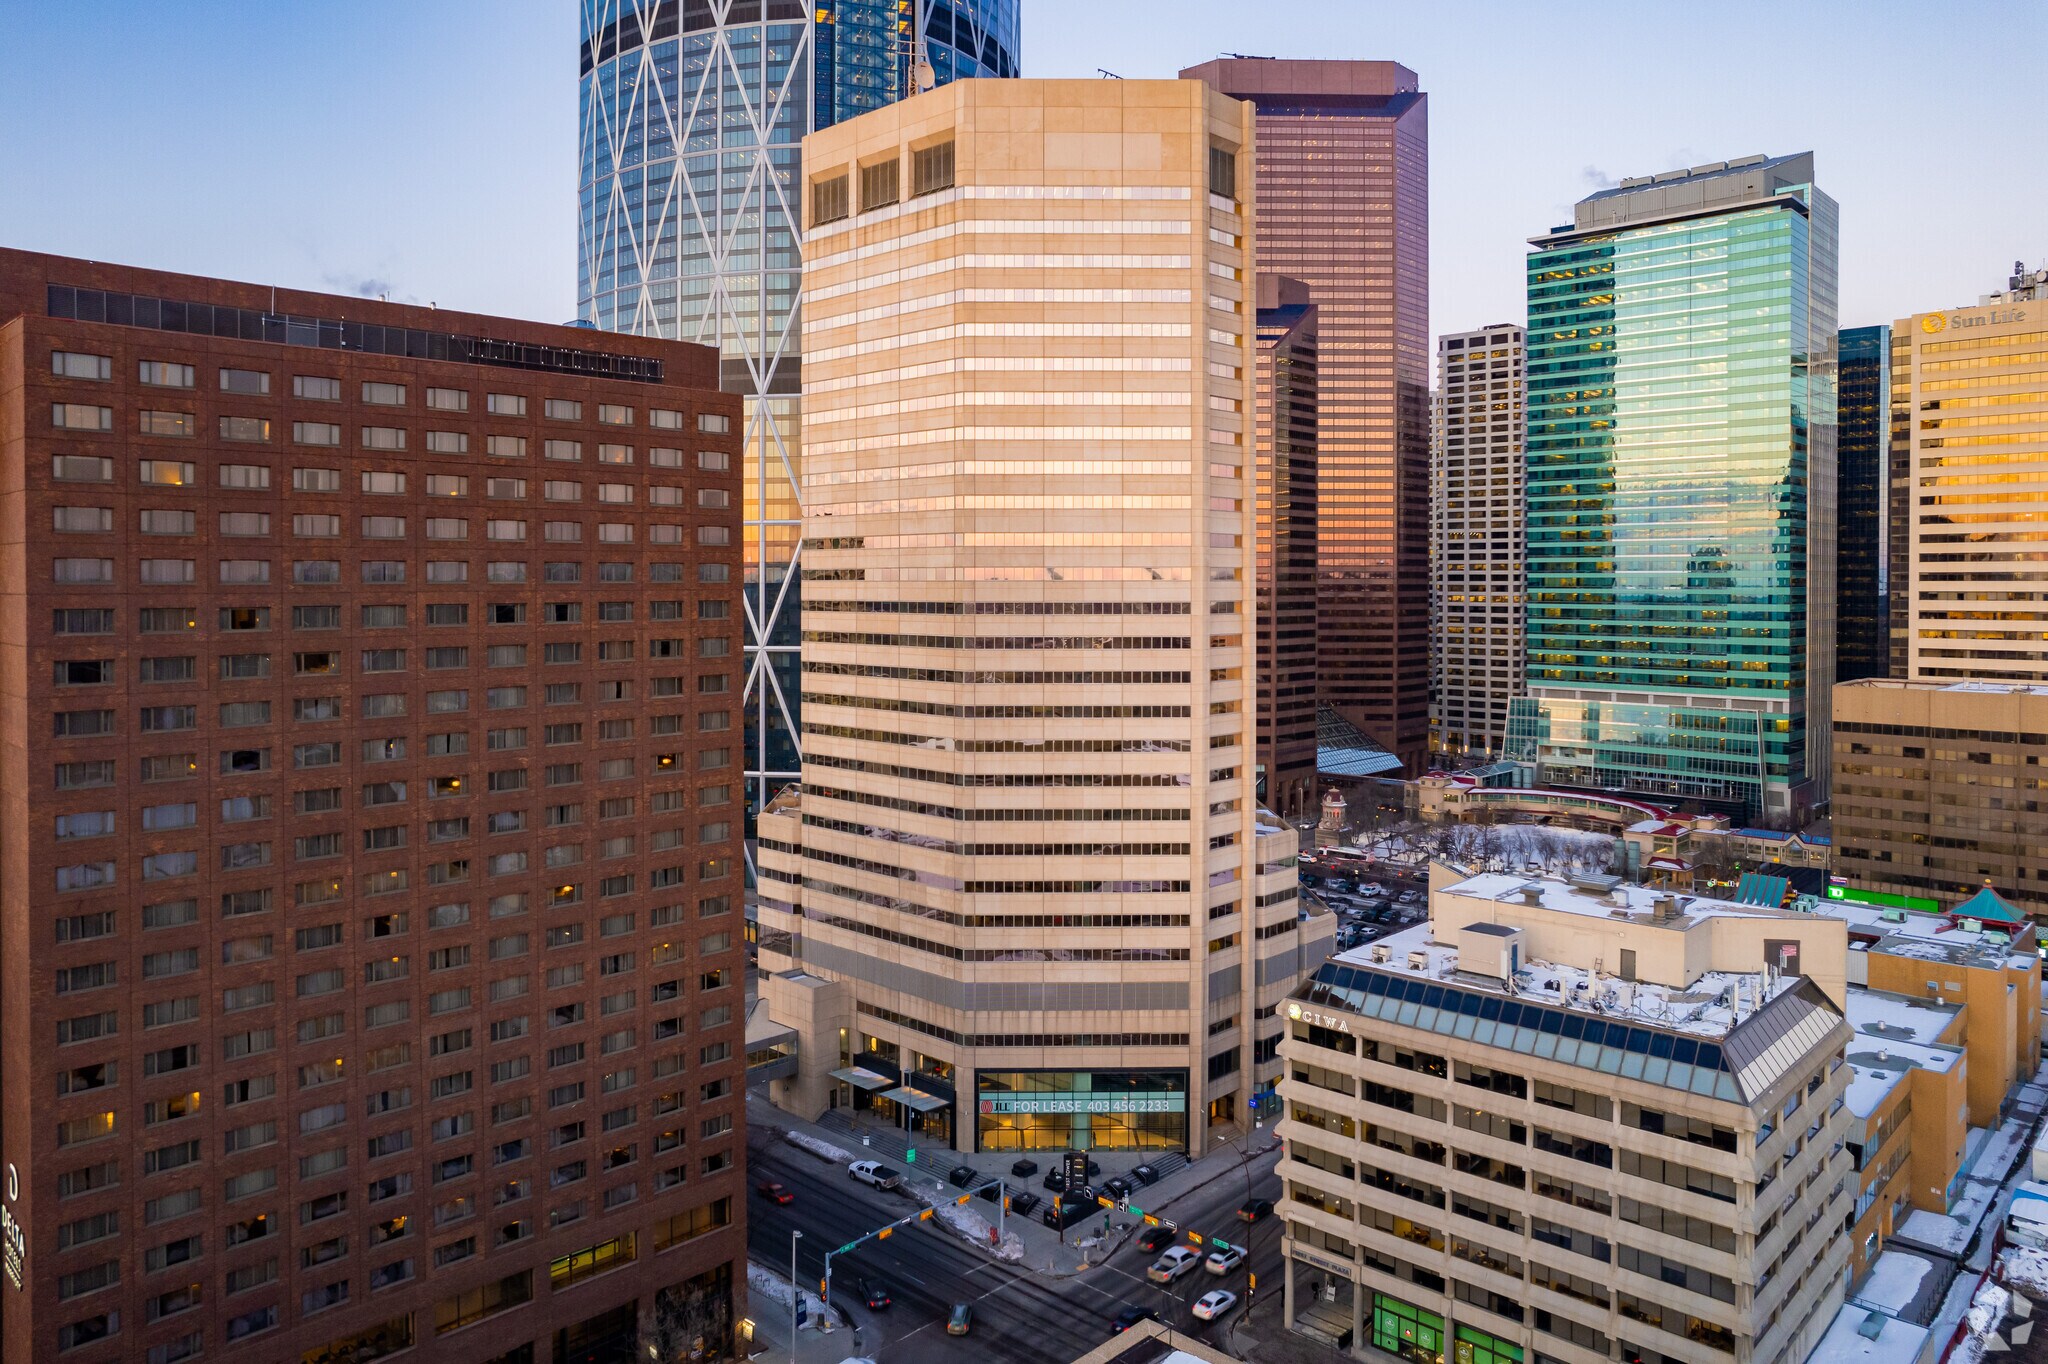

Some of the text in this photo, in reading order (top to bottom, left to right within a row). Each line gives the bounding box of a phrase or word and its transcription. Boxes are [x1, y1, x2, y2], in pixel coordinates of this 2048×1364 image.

[1951, 308, 2026, 329] Sun Life
[1829, 887, 1844, 897] TD
[1302, 1011, 1349, 1032] CIWA
[1013, 1101, 1039, 1113] FOR
[1043, 1101, 1082, 1113] LEASE
[1087, 1101, 1110, 1112] 403
[1113, 1101, 1136, 1112] 456
[1139, 1100, 1170, 1112] 2233
[1, 1204, 25, 1258] DELTA
